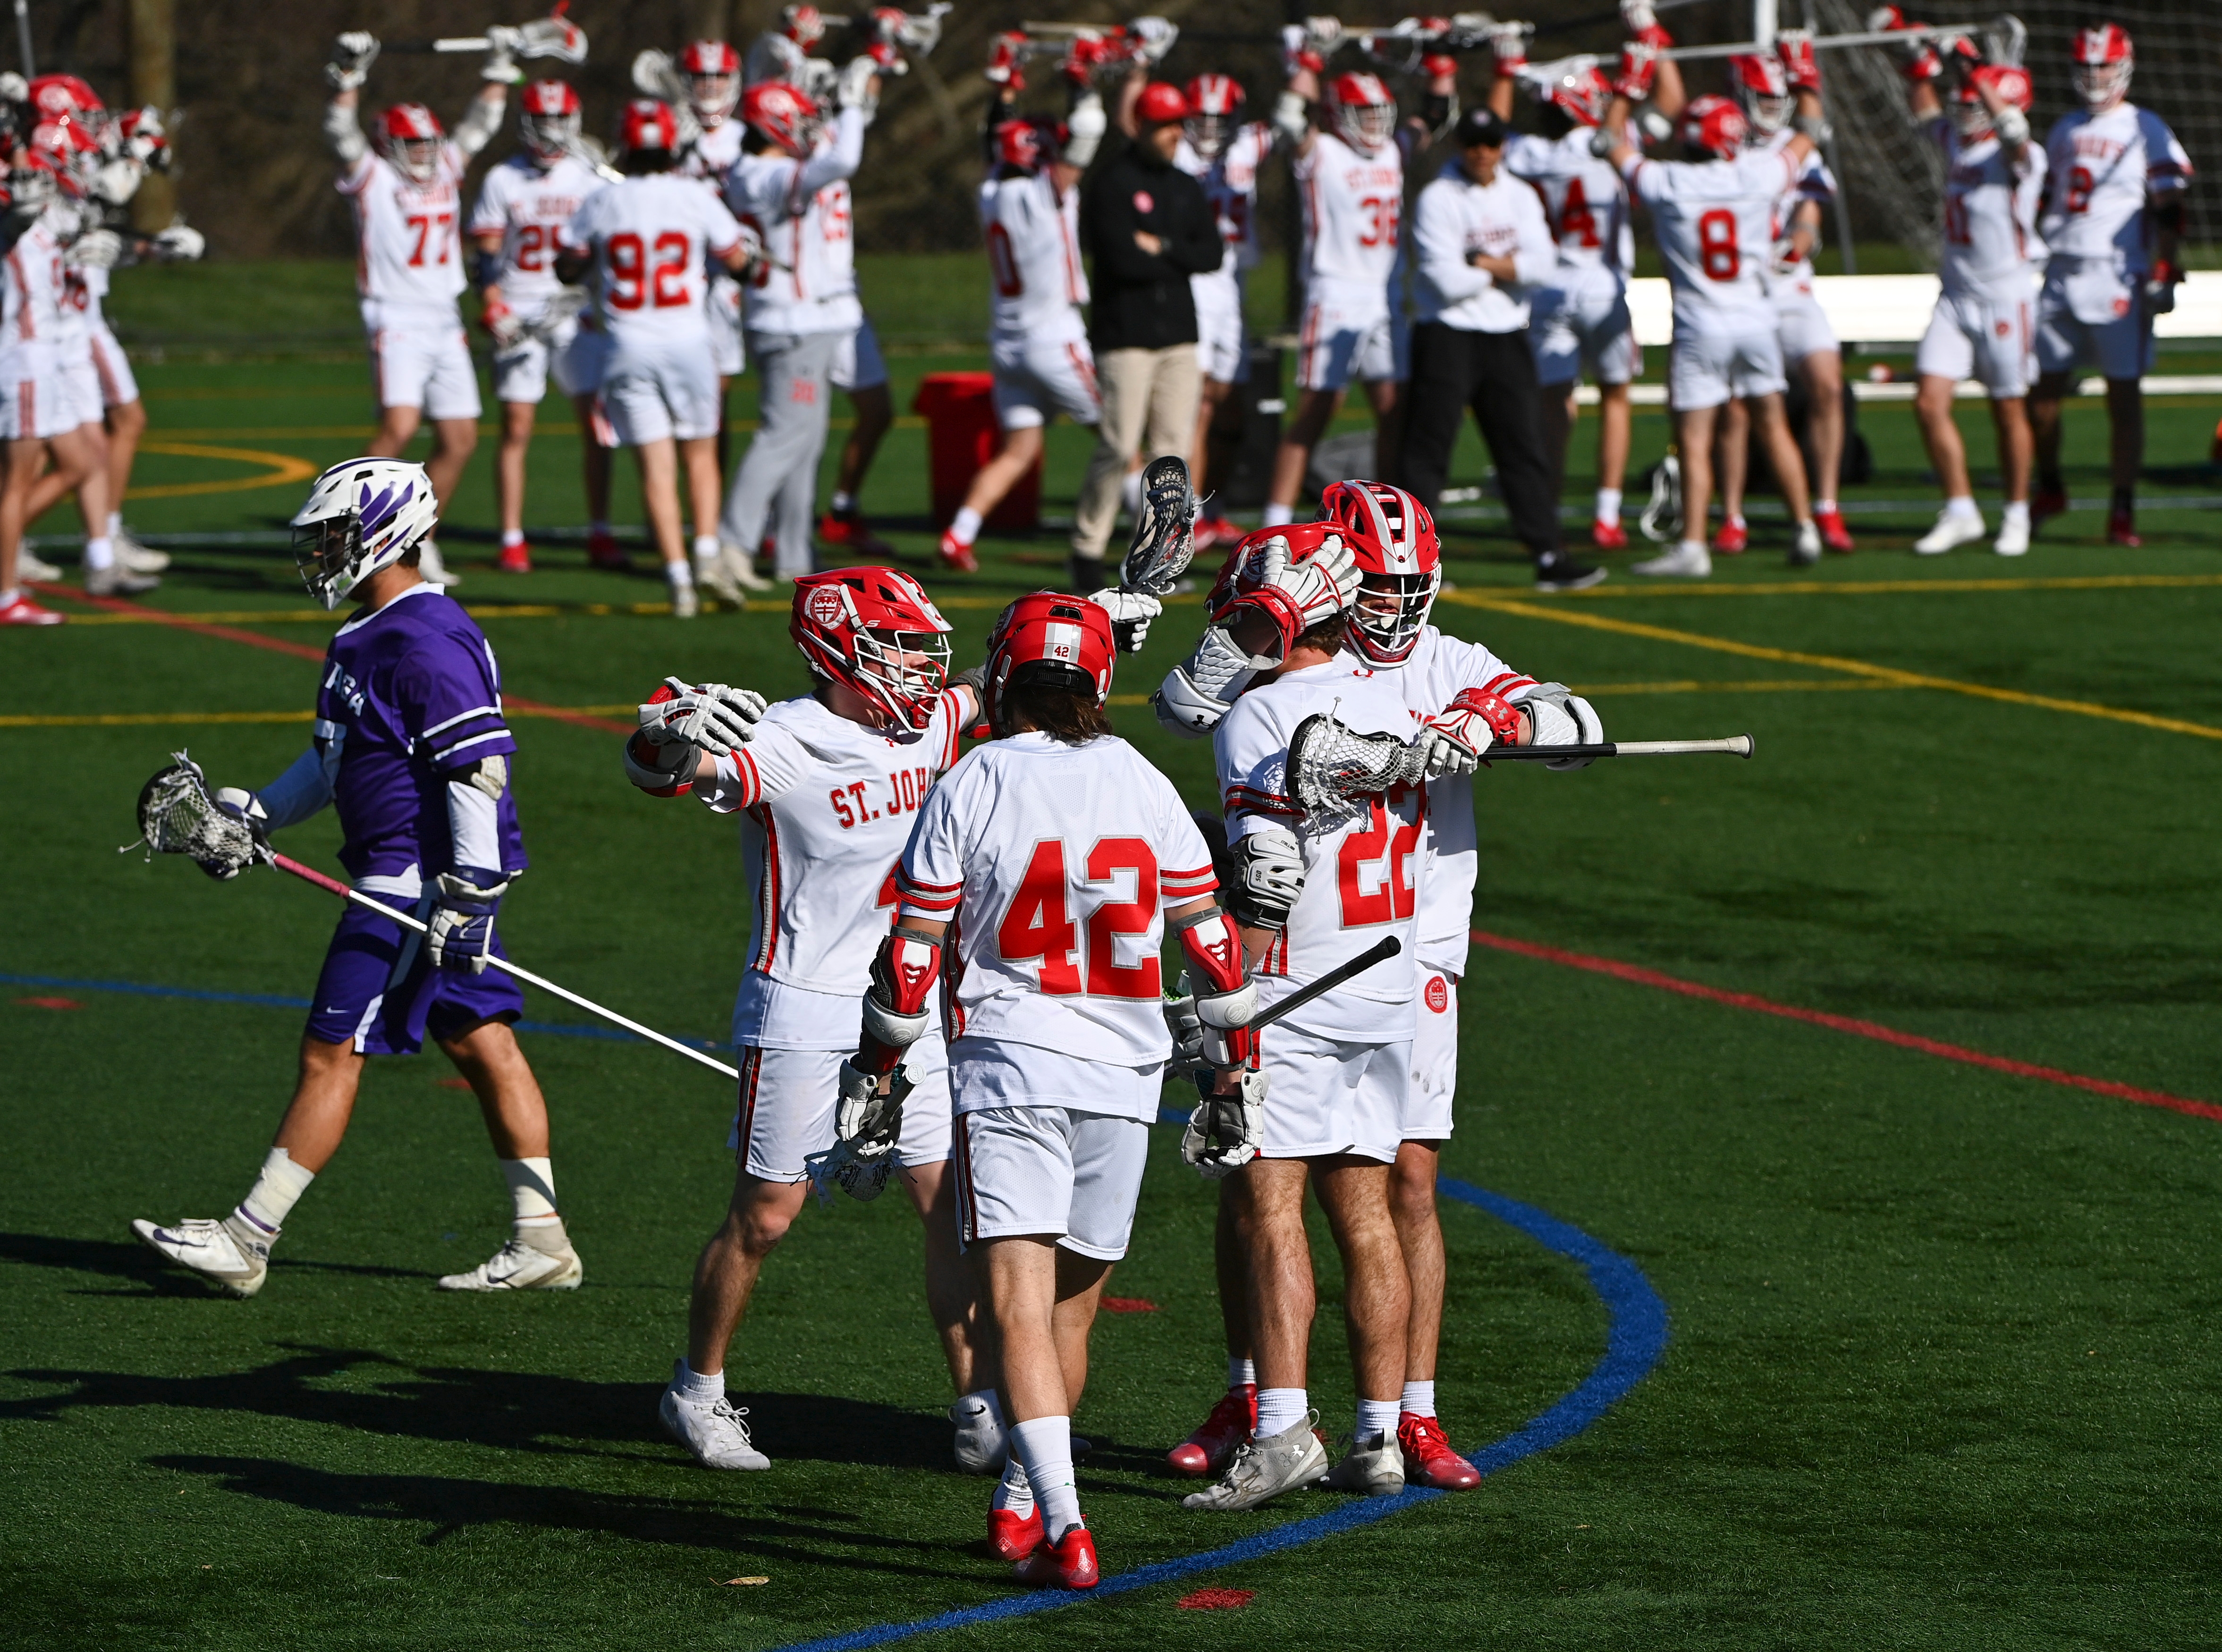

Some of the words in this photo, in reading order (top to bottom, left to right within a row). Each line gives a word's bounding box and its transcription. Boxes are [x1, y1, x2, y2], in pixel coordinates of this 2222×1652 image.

[407, 214, 452, 267] 77
[1699, 209, 1740, 280] 8
[608, 233, 690, 311] 92
[1049, 597, 1087, 607] cascade
[1293, 604, 1305, 633] UNDER
[1054, 645, 1069, 657] 42
[828, 780, 881, 830] ST.
[1334, 768, 1428, 931] 22
[993, 834, 1163, 1003] 42
